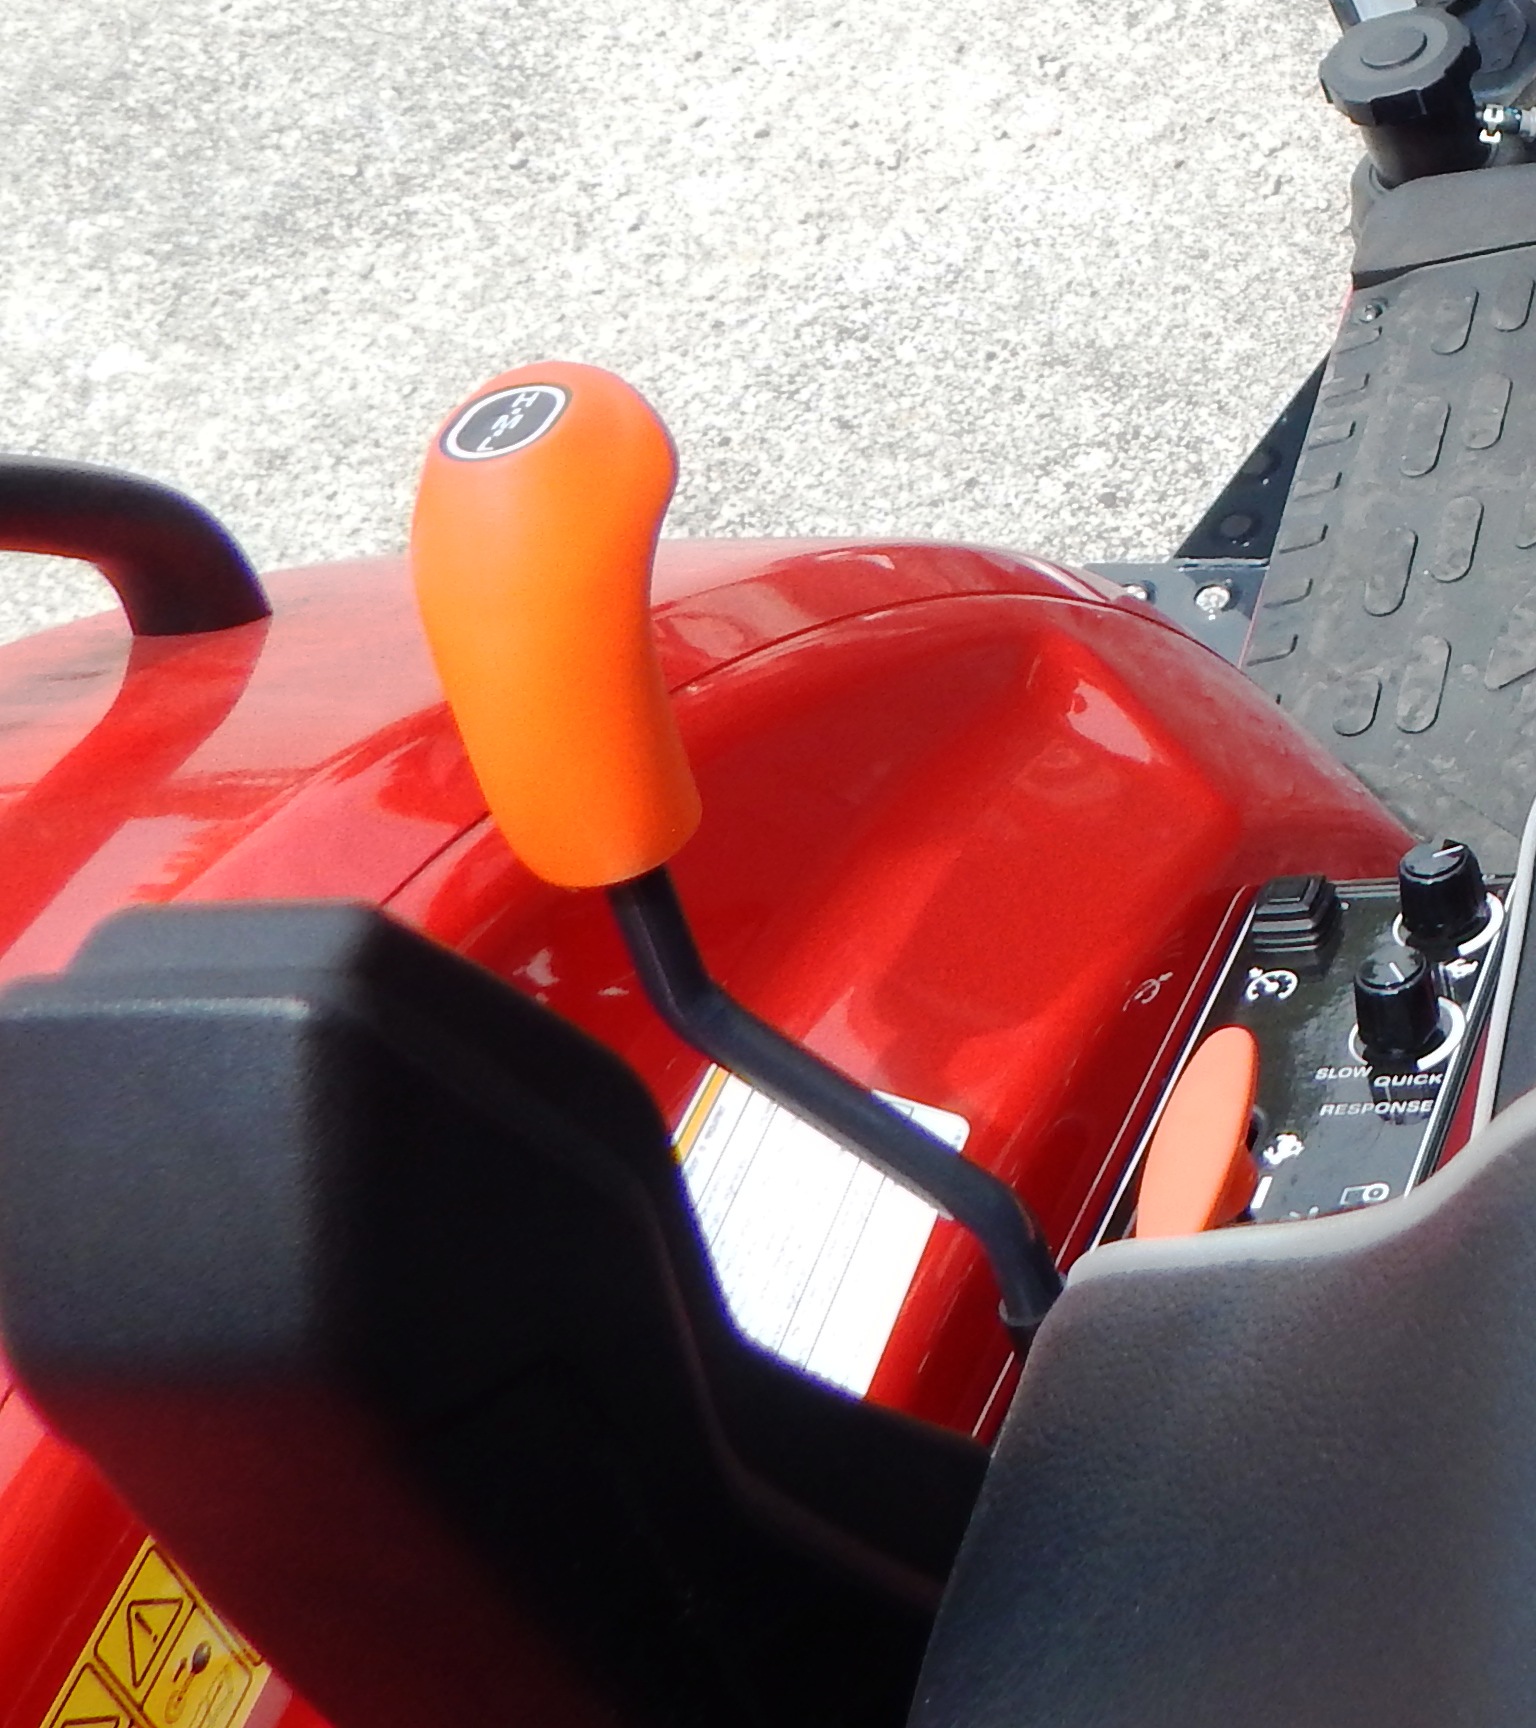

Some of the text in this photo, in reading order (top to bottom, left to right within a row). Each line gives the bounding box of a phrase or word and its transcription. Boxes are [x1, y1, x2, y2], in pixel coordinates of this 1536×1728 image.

[511, 391, 540, 408] H
[491, 414, 524, 430] M
[476, 436, 494, 452] L
[1315, 1065, 1443, 1087] SLOW QUICK
[1320, 1099, 1434, 1116] RESPONSE
